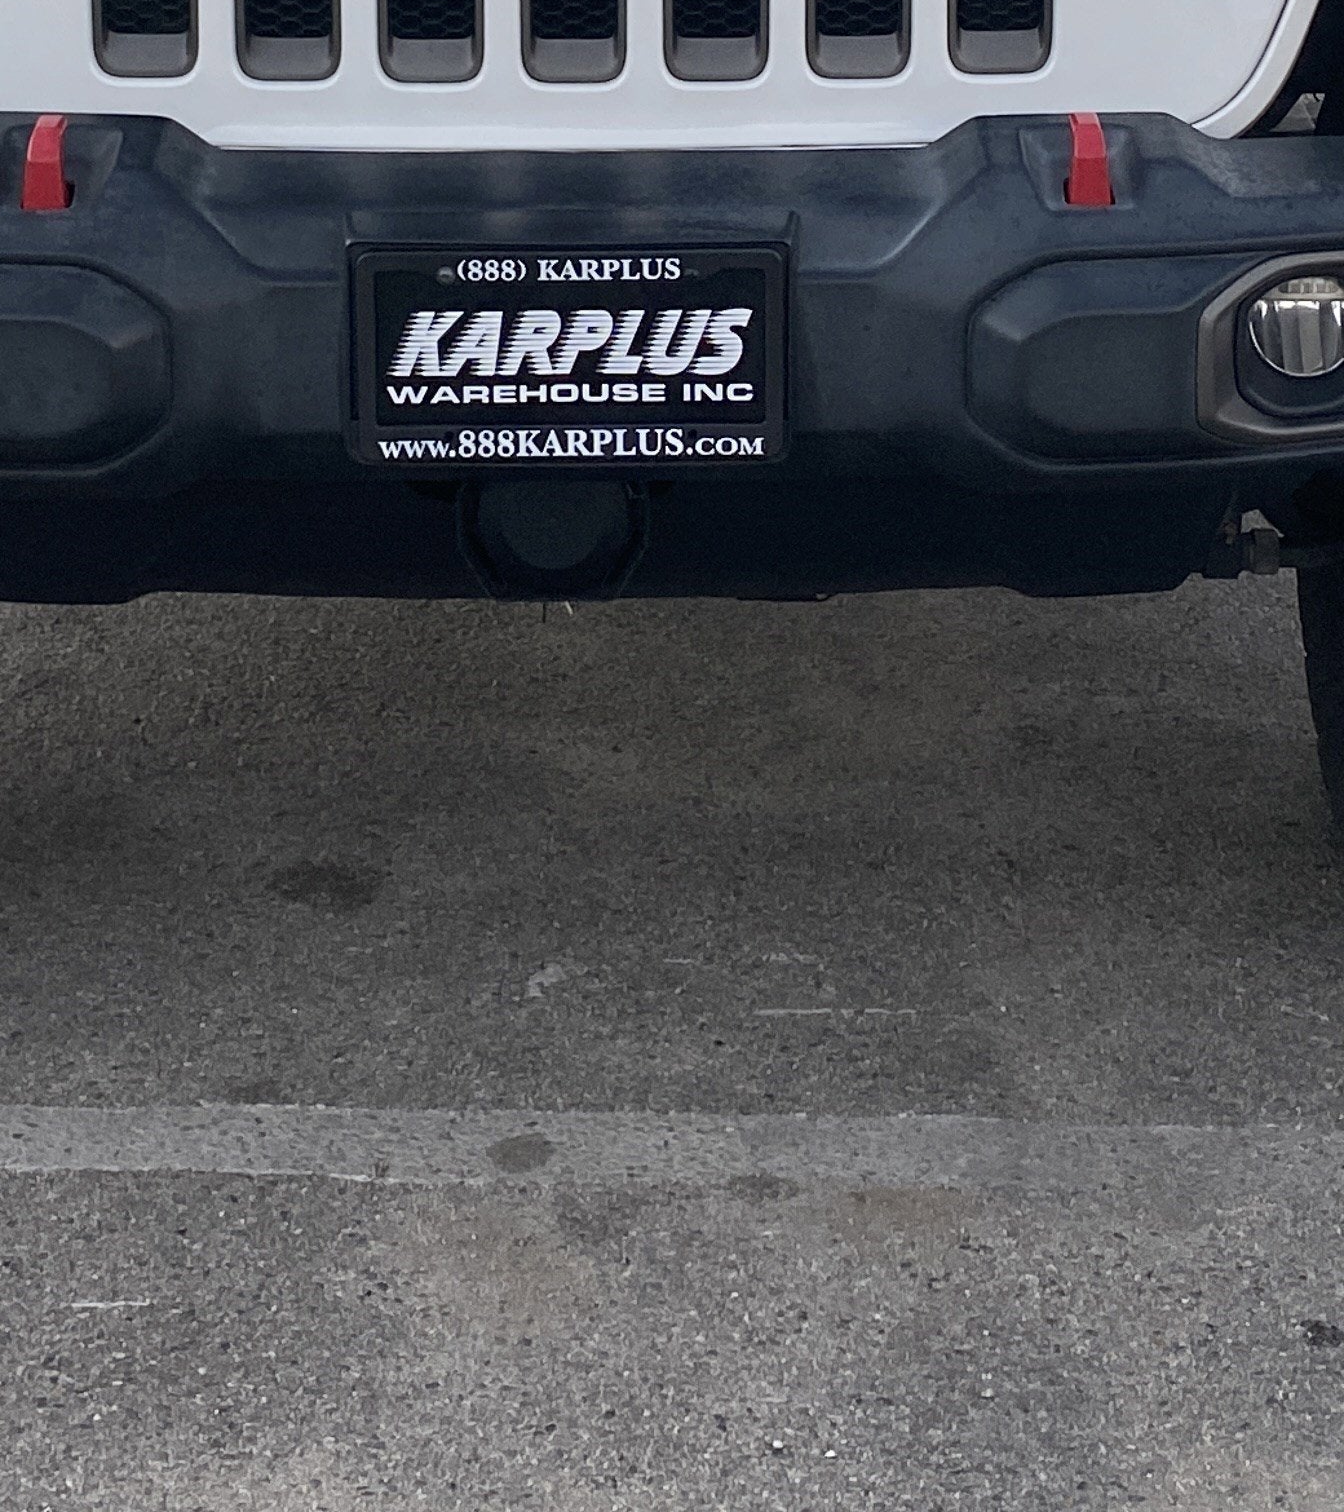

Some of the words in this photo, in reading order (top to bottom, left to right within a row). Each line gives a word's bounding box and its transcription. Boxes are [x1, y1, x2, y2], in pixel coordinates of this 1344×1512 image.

[457, 259, 526, 281] (888)
[537, 258, 681, 281] KARPLUS
[385, 308, 753, 377] KARPLUS
[386, 384, 666, 405] WAREHOUSE
[683, 383, 754, 402] INC
